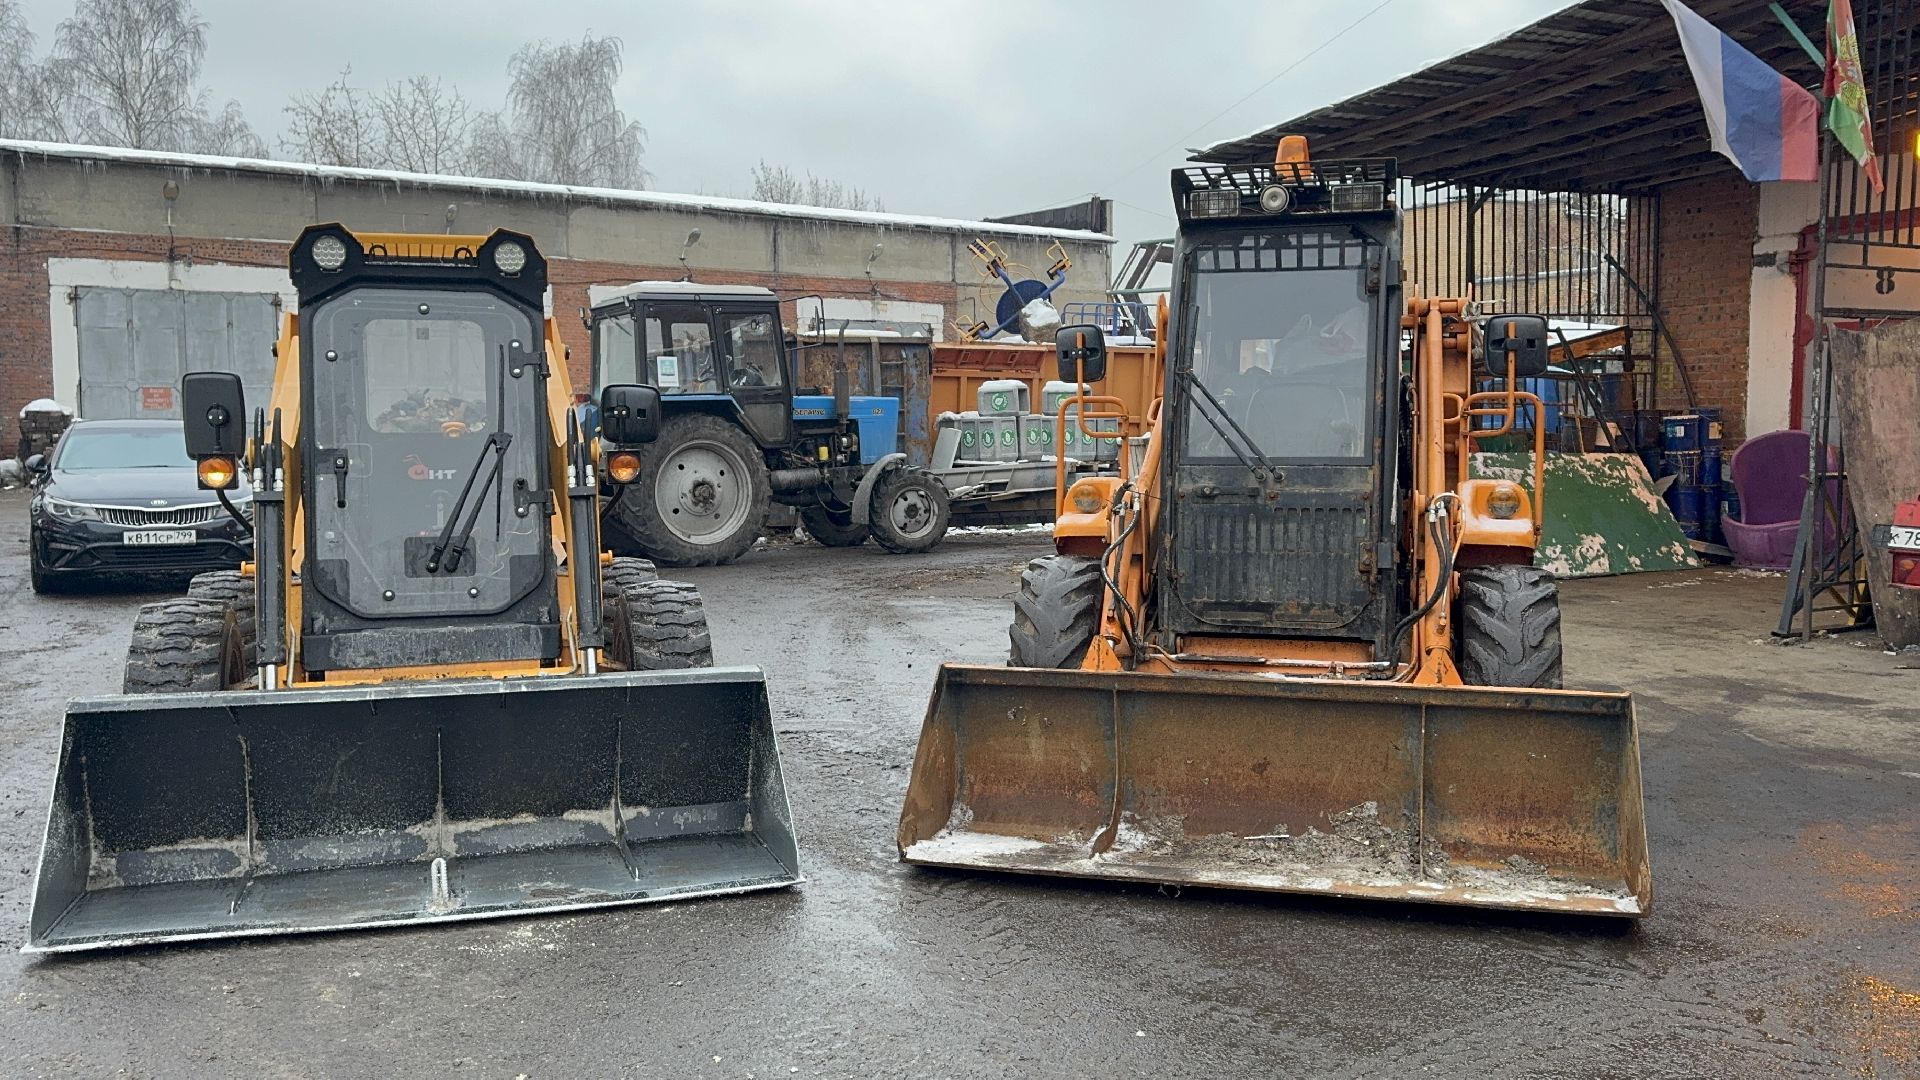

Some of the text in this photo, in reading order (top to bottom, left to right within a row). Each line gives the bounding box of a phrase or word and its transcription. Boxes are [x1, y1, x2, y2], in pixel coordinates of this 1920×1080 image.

[1876, 267, 1895, 295] 8
[127, 531, 193, 544] К811СР 799
